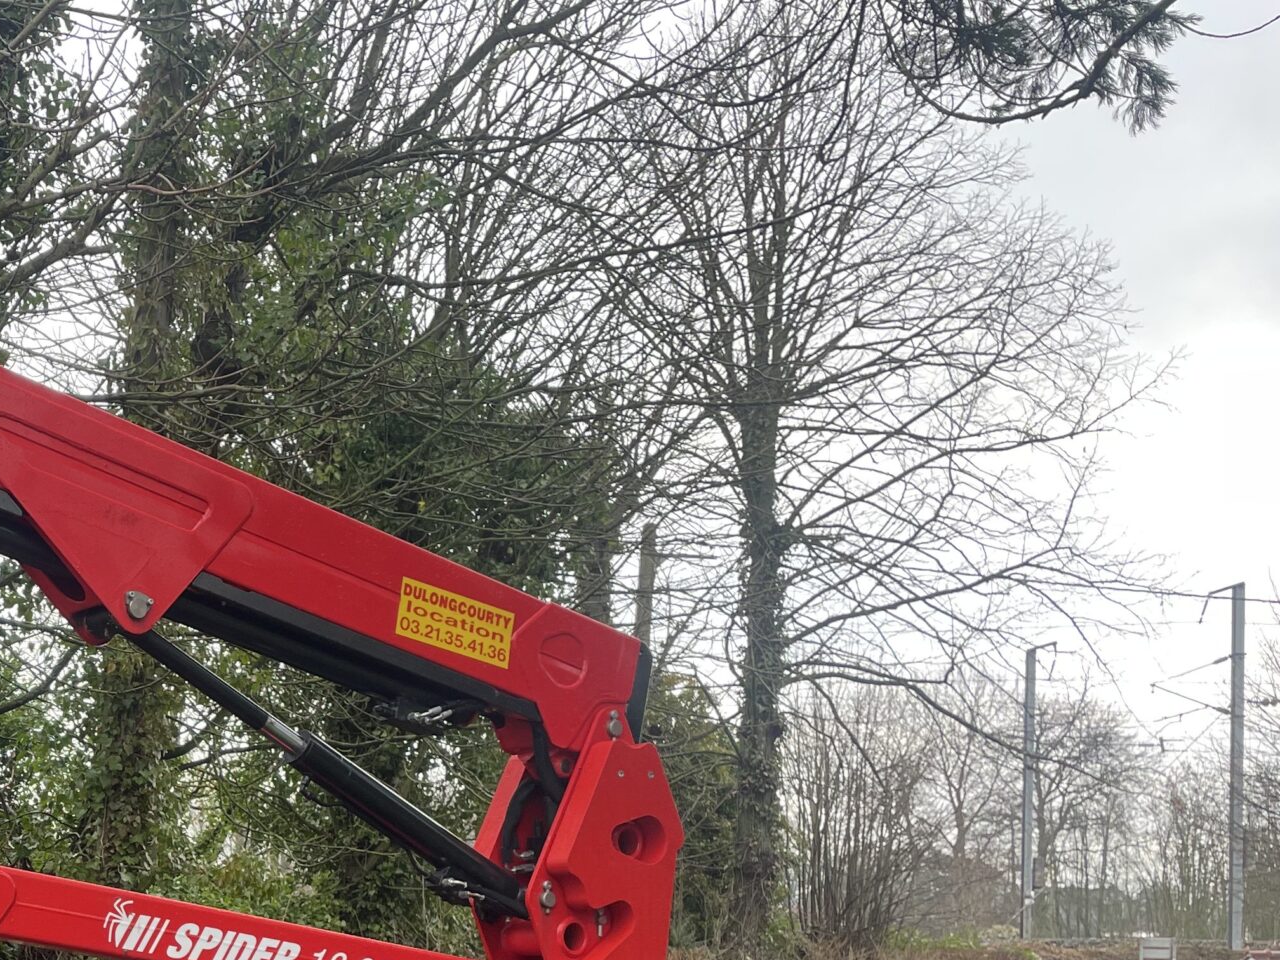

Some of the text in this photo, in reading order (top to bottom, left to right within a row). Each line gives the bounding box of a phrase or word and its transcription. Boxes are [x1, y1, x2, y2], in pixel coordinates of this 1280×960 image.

[403, 582, 511, 629] DULONGCOURTY
[406, 600, 504, 643] location
[400, 616, 506, 662] 03.21.35.41.36
